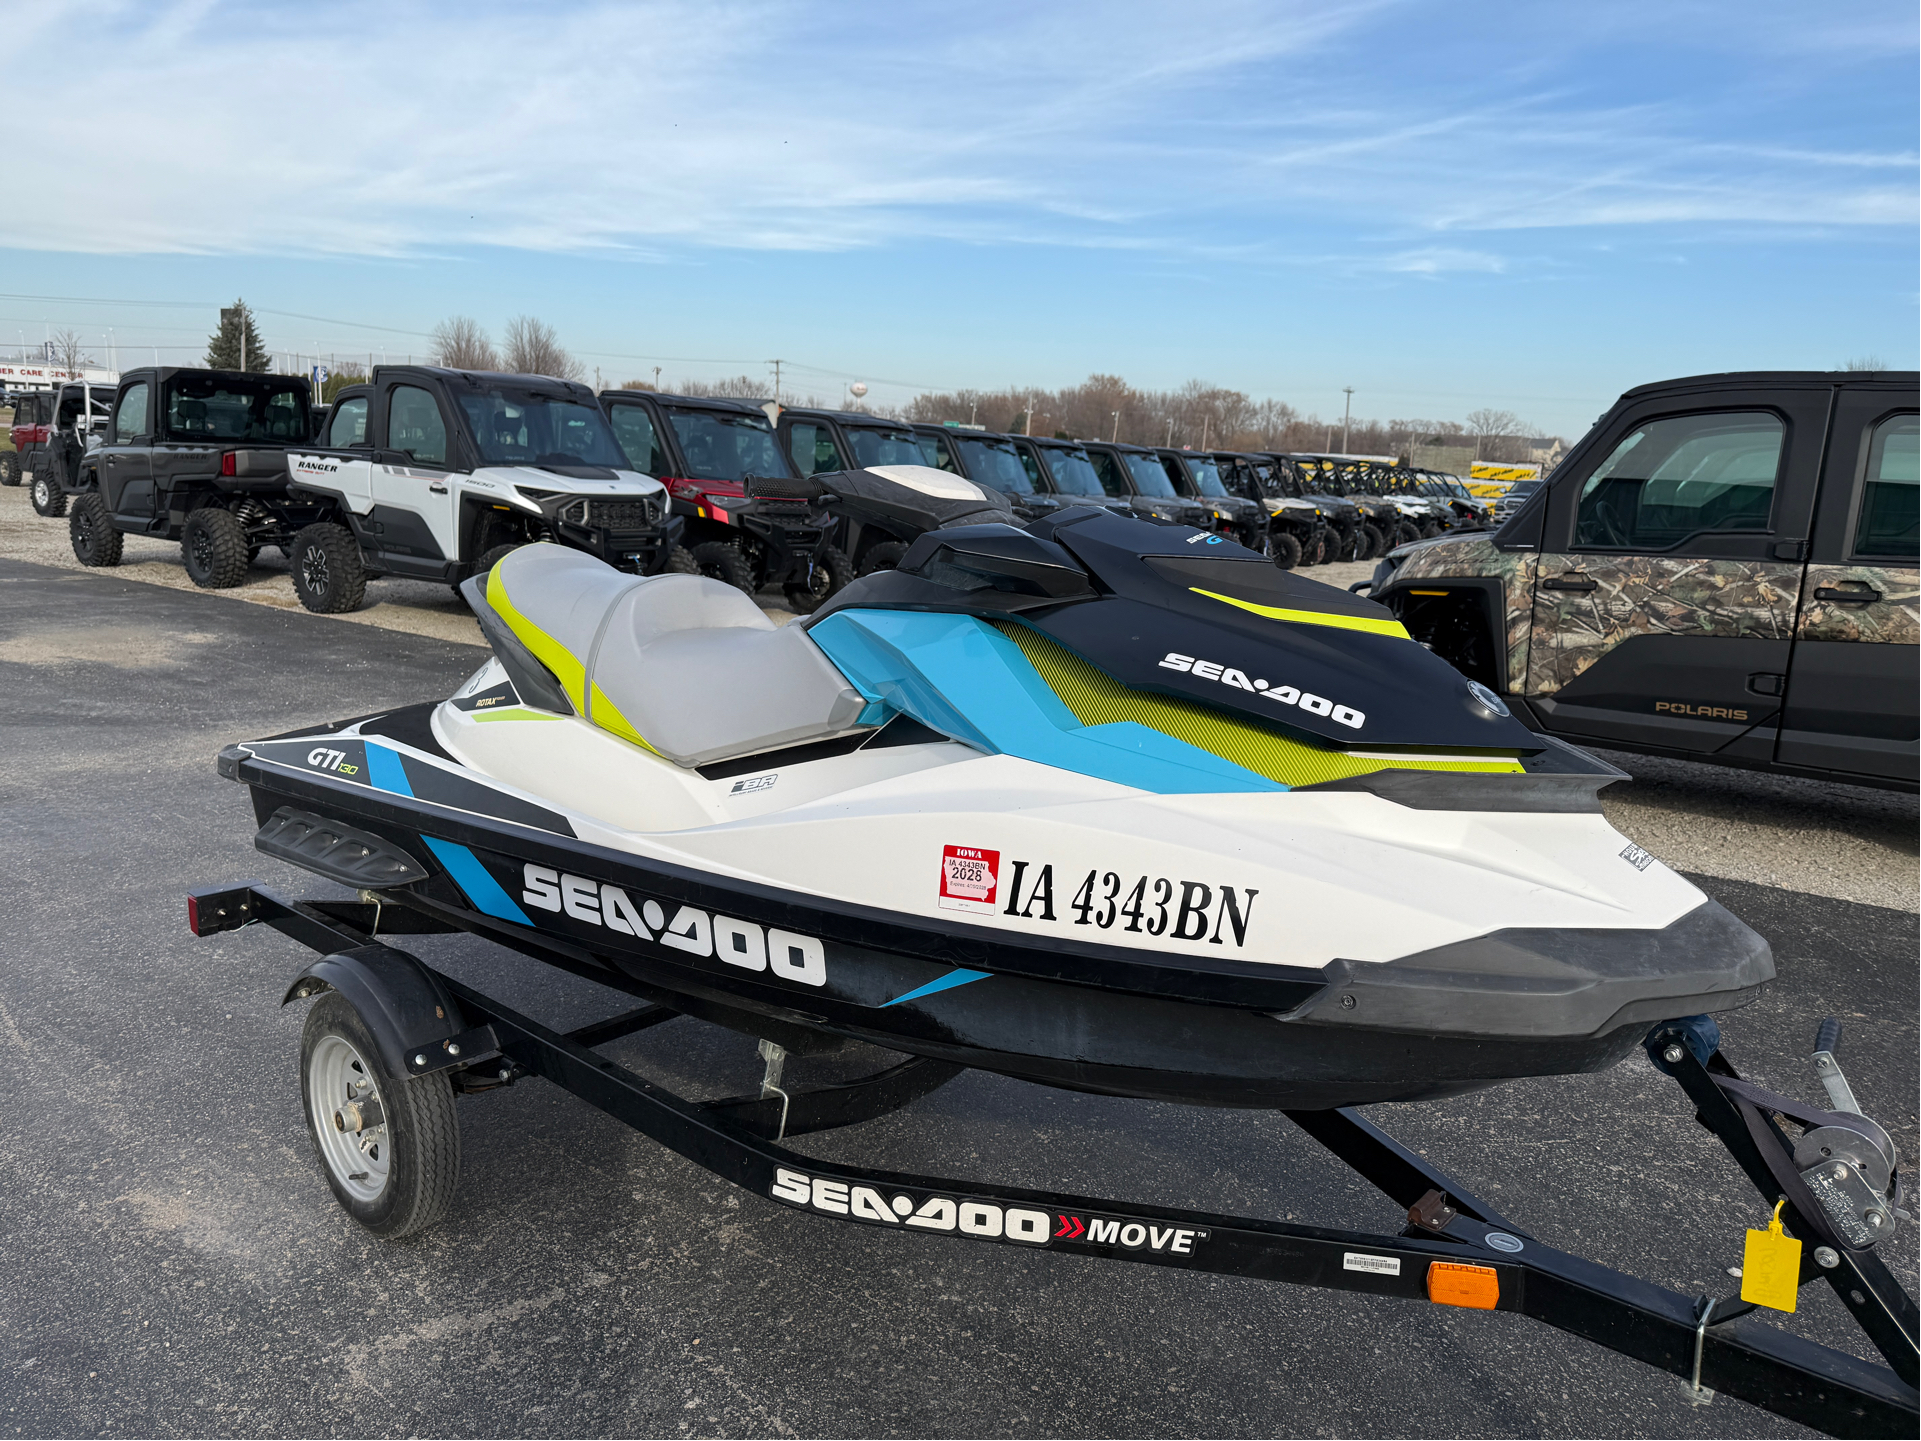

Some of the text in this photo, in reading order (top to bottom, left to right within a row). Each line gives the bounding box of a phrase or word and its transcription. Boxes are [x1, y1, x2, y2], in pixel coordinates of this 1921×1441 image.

[20, 369, 43, 377] CARE
[50, 371, 83, 379] CENR
[298, 461, 338, 472] RANGER
[476, 697, 497, 707] ROTAX
[1655, 701, 1748, 720] POLARIS
[307, 747, 359, 775] GTI 130
[956, 848, 982, 859] IOWA
[949, 859, 985, 870] IA 4343BN
[1003, 860, 1259, 947] IA 4343BN
